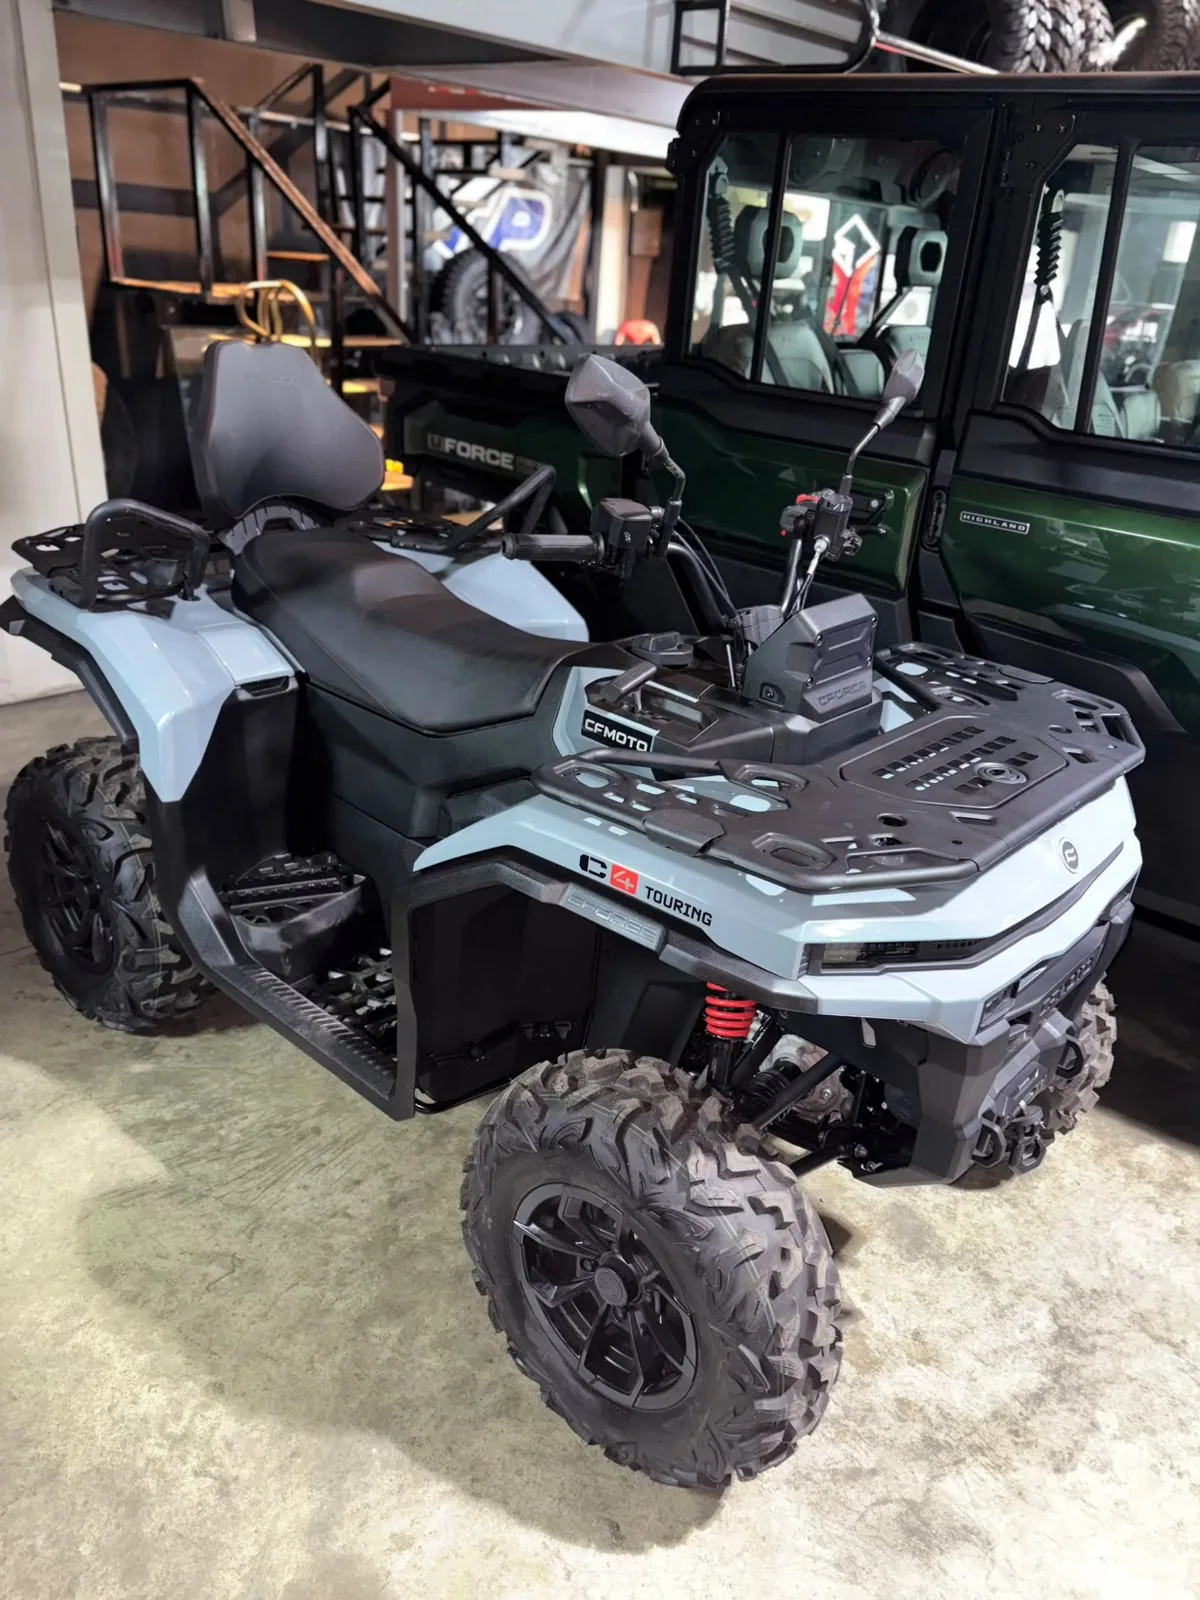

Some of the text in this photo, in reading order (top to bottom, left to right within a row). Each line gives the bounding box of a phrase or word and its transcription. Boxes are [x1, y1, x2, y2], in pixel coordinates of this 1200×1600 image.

[962, 513, 1027, 531] HIGHLAND
[584, 718, 648, 752] CFMOTO
[645, 885, 713, 926] TOURING
